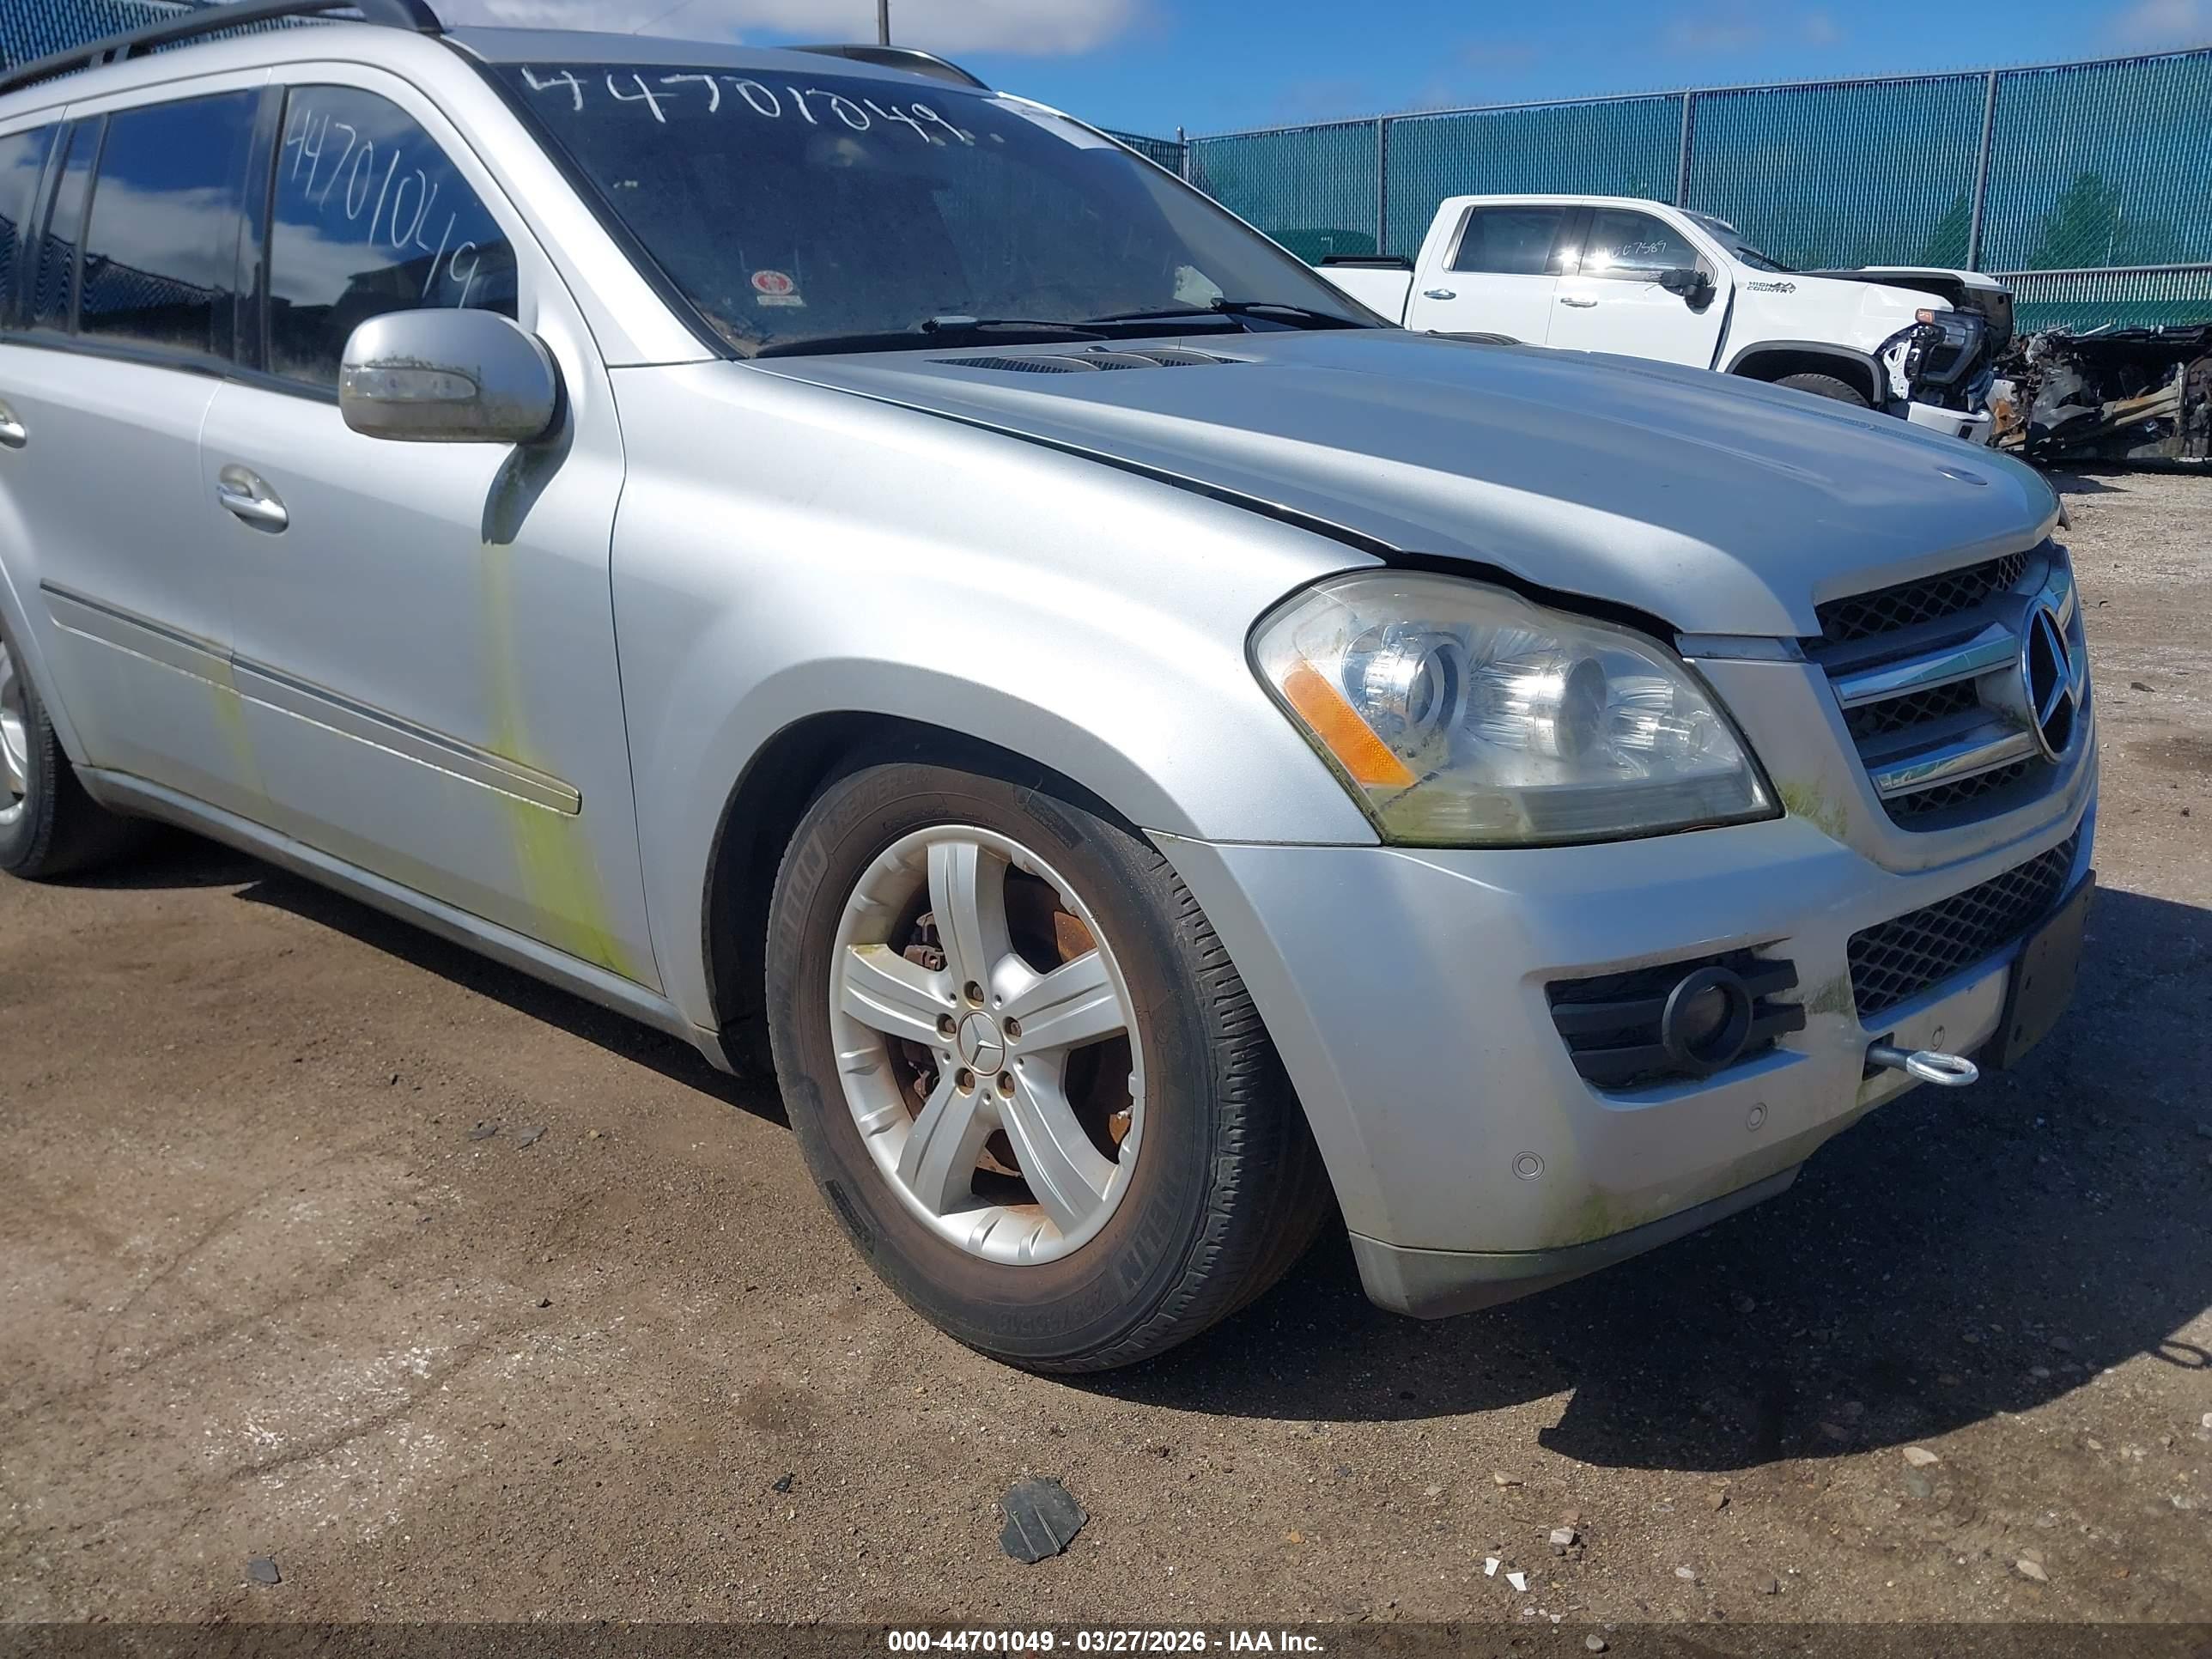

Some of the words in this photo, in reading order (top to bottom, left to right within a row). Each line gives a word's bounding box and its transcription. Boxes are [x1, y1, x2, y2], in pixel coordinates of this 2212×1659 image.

[520, 66, 965, 143] 44701049
[286, 108, 480, 310] 44701049
[1746, 285, 1796, 295] COUNTRY
